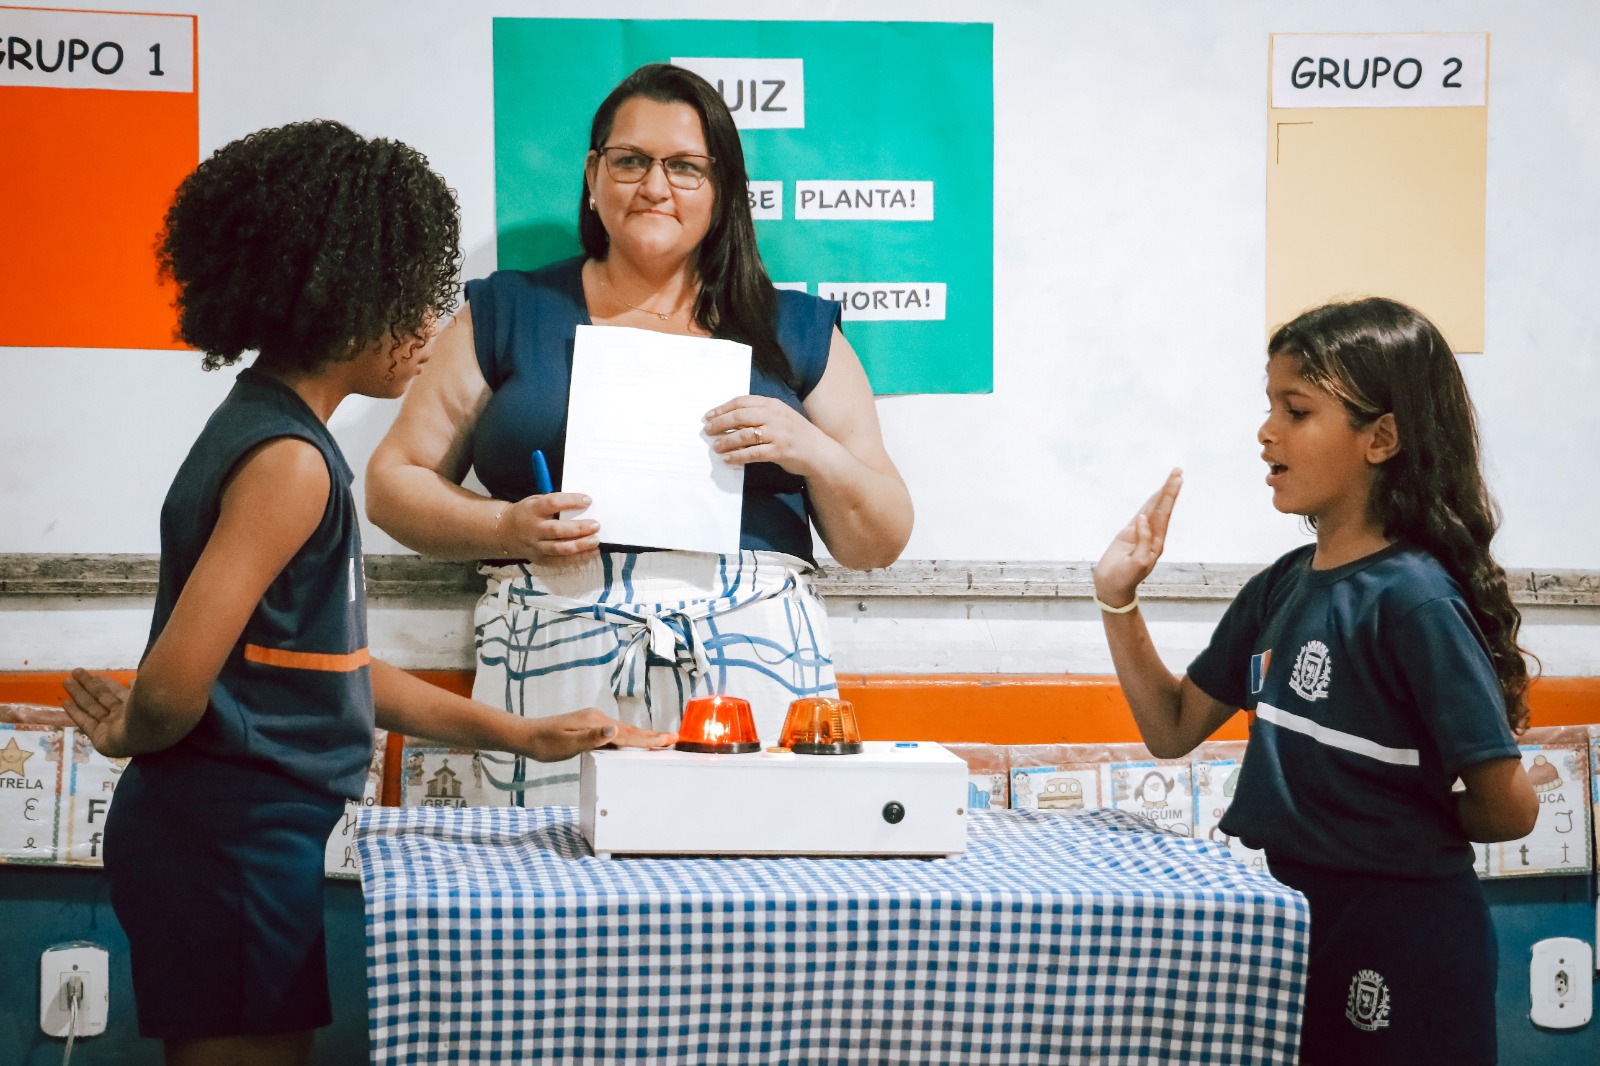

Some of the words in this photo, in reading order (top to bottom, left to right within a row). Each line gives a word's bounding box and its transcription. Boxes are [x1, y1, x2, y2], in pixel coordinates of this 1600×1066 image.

[0, 36, 124, 75] RUPO
[148, 42, 165, 76] 1
[1290, 56, 1422, 89] GRUPO
[1441, 57, 1463, 88] 2
[800, 188, 916, 209] PLANTA!
[830, 288, 931, 311] HORTA!
[88, 799, 108, 824] F
[1137, 809, 1183, 821] NGUIM
[1519, 844, 1530, 866] t
